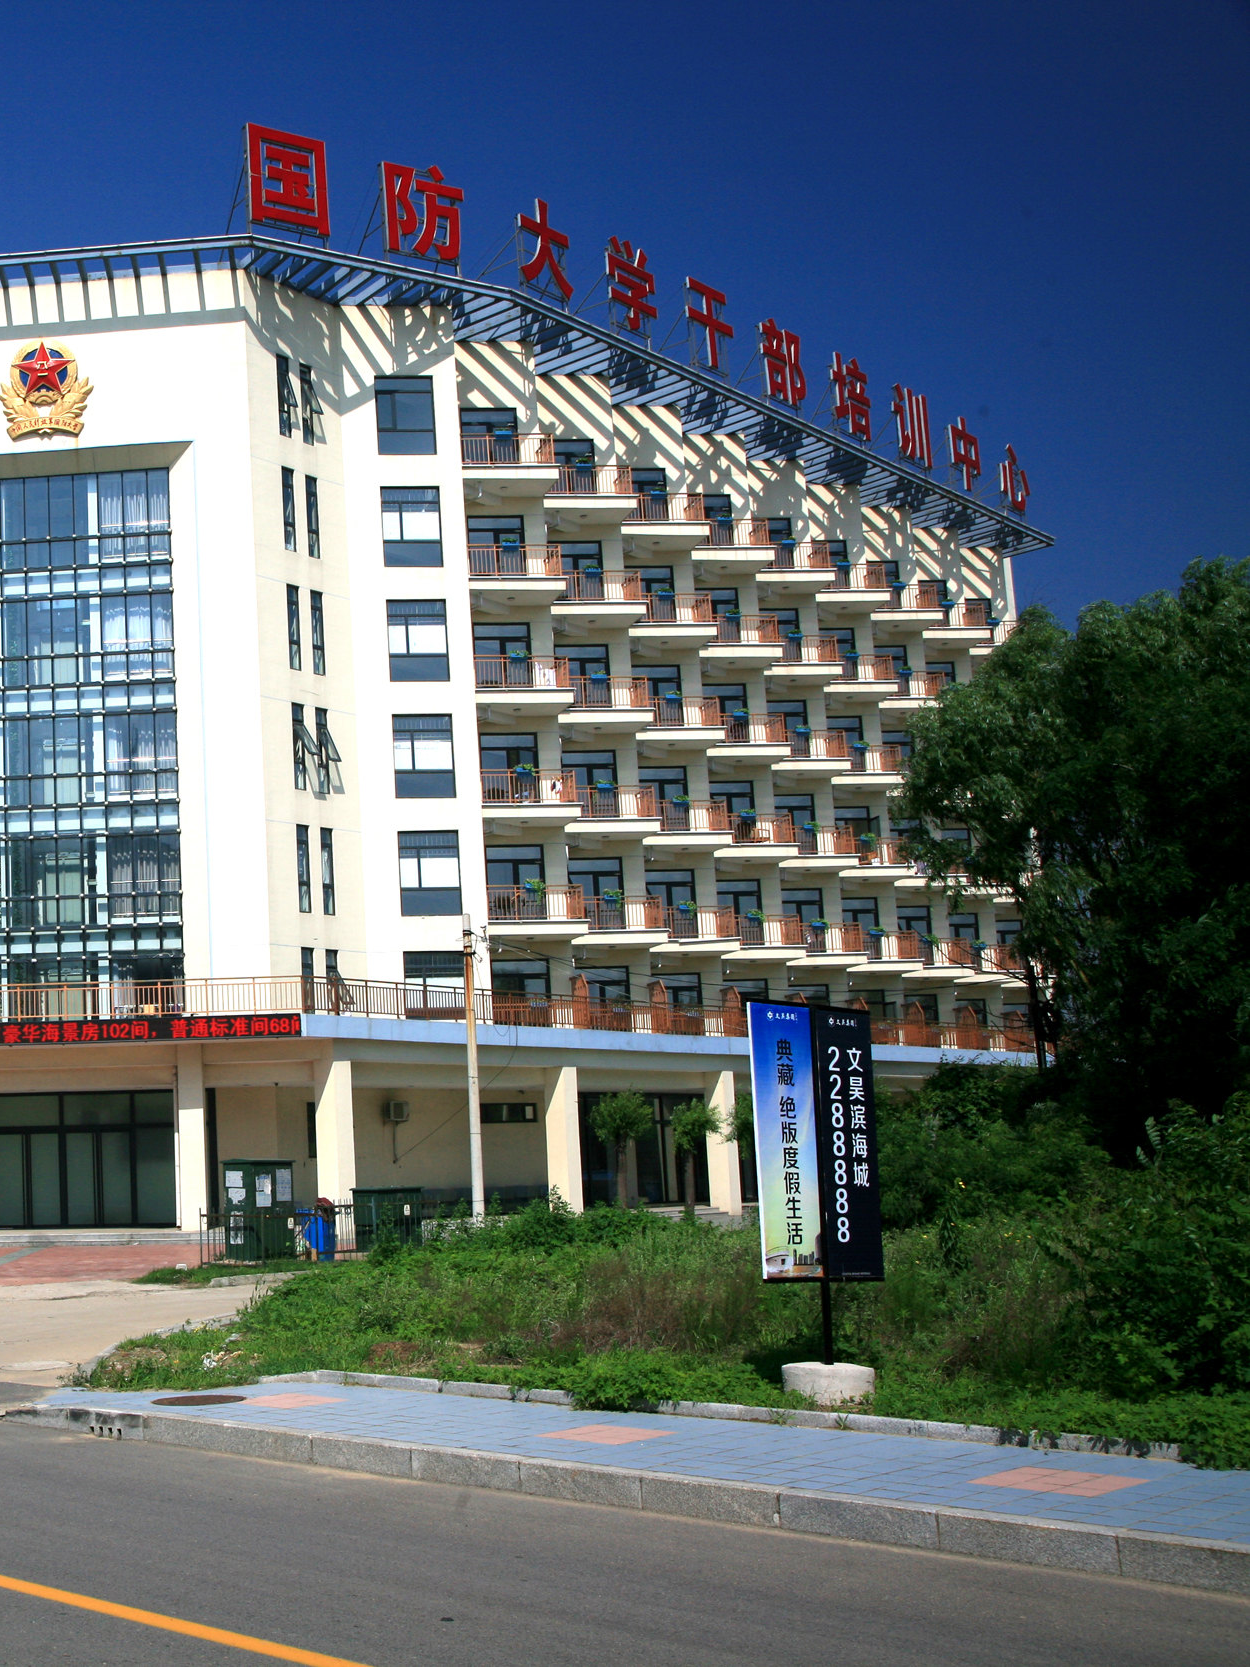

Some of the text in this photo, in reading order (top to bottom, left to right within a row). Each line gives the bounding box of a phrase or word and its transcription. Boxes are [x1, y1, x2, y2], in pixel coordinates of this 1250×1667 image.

[246, 122, 1031, 514] 国防大学干部培训中心
[776, 1039, 803, 1246] 典藏 绝版度假生活
[827, 1046, 850, 1244] 2288888
[846, 1046, 870, 1188] 文昊滨海城
